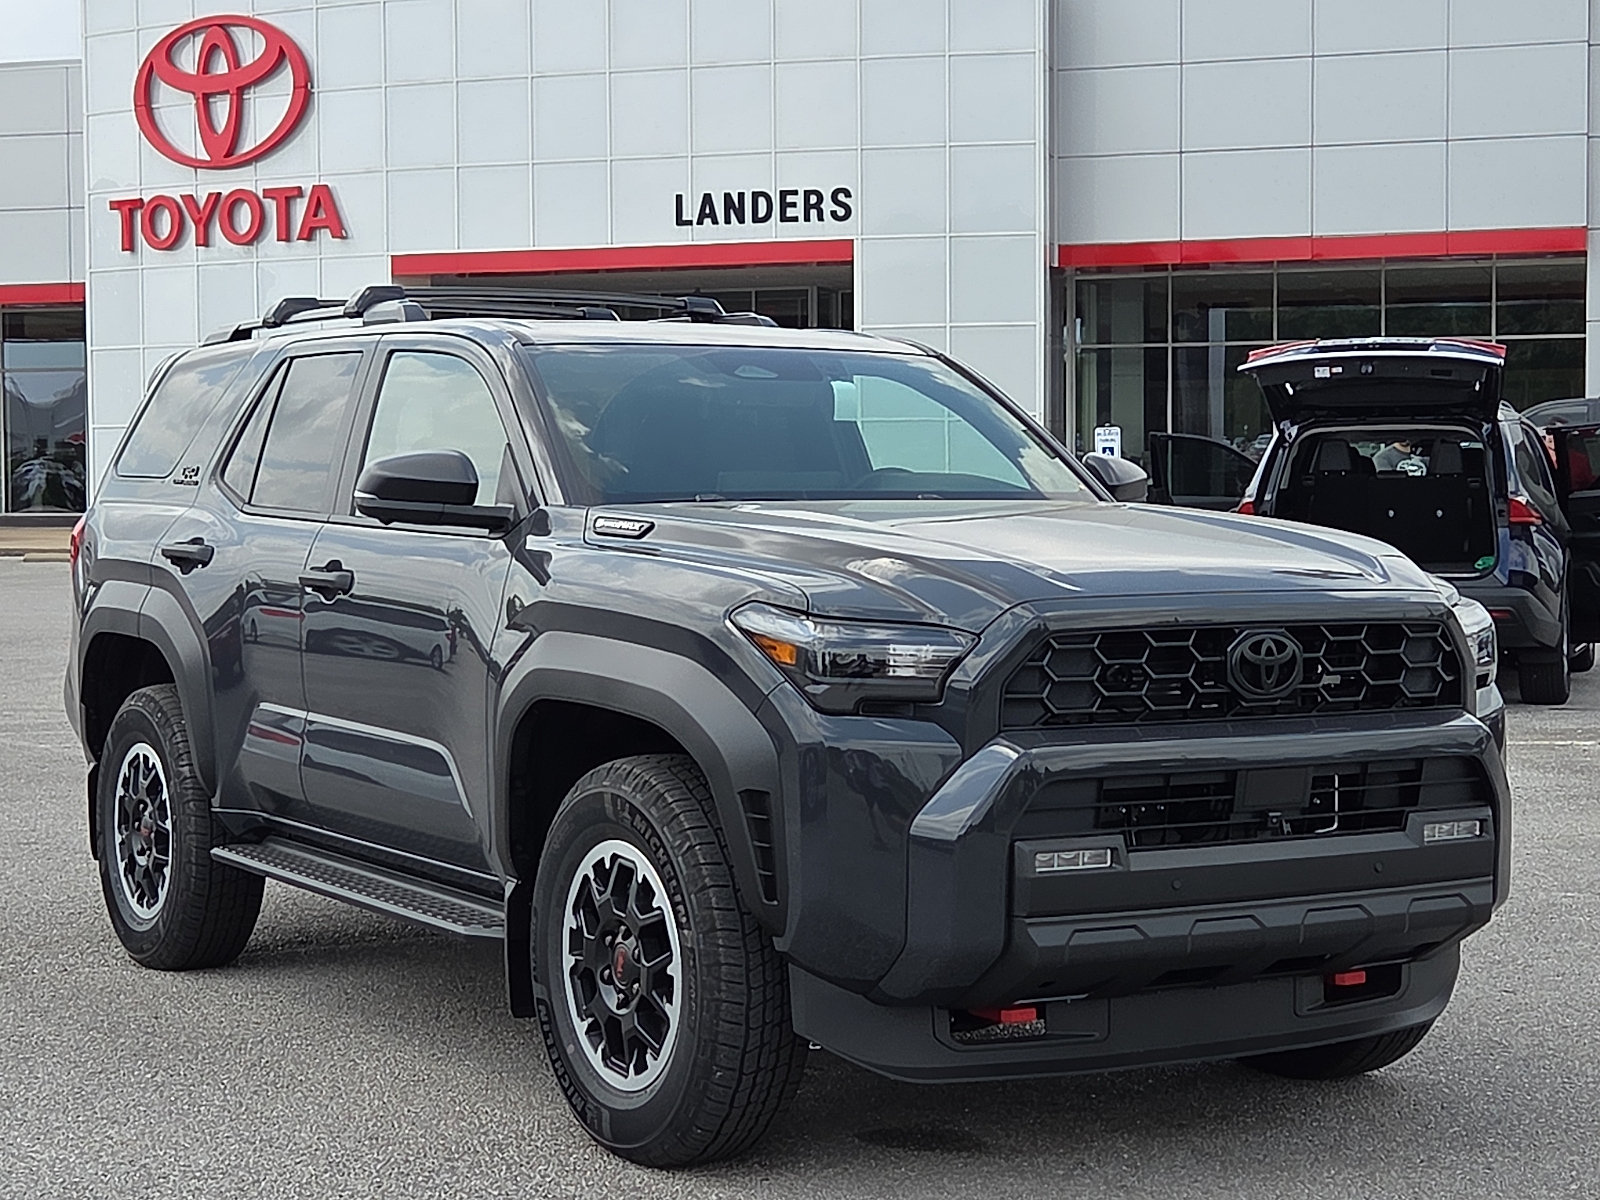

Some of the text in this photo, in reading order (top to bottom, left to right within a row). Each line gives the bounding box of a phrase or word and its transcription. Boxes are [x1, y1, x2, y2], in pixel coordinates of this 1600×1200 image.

[109, 184, 348, 252] TOYOTA
[675, 187, 852, 226] LANDERS
[631, 813, 689, 924] MICHELIN
